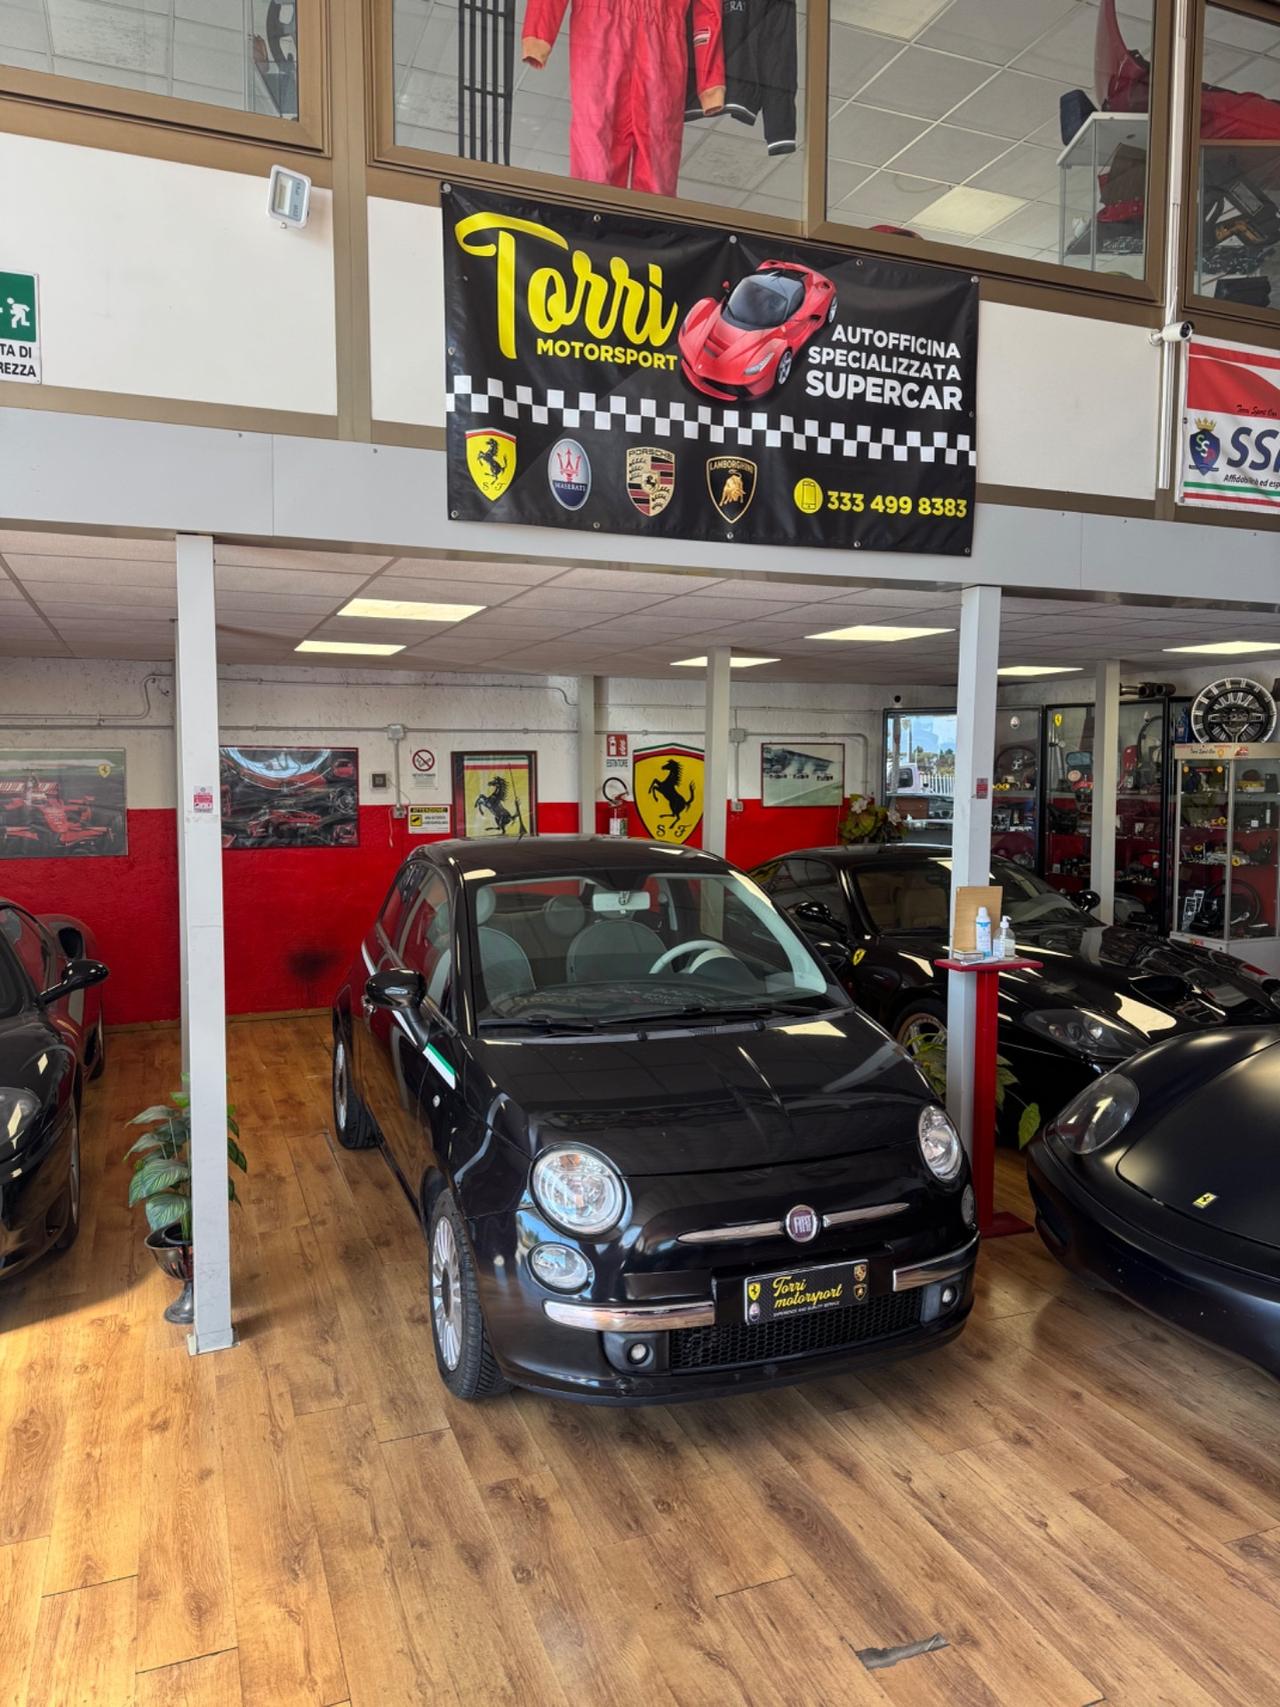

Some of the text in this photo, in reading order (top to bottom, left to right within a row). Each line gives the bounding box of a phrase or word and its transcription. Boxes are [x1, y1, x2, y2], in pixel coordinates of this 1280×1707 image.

[455, 211, 679, 359] Torri
[19, 345, 32, 359] DI
[536, 338, 678, 371] MOTORSPORT
[831, 324, 961, 359] AUTOFFICINA
[807, 345, 962, 381] SPECIALIZZATA
[805, 369, 963, 411] SUPERCAR
[628, 448, 673, 460] PORSCHE
[709, 460, 754, 473] LAMBORGHINI
[554, 482, 586, 492] MASERATI
[827, 490, 967, 519] 333 499 8383
[793, 1214, 813, 1234] FIAT
[772, 1276, 808, 1297] Torri
[774, 1283, 843, 1309] motorsport
